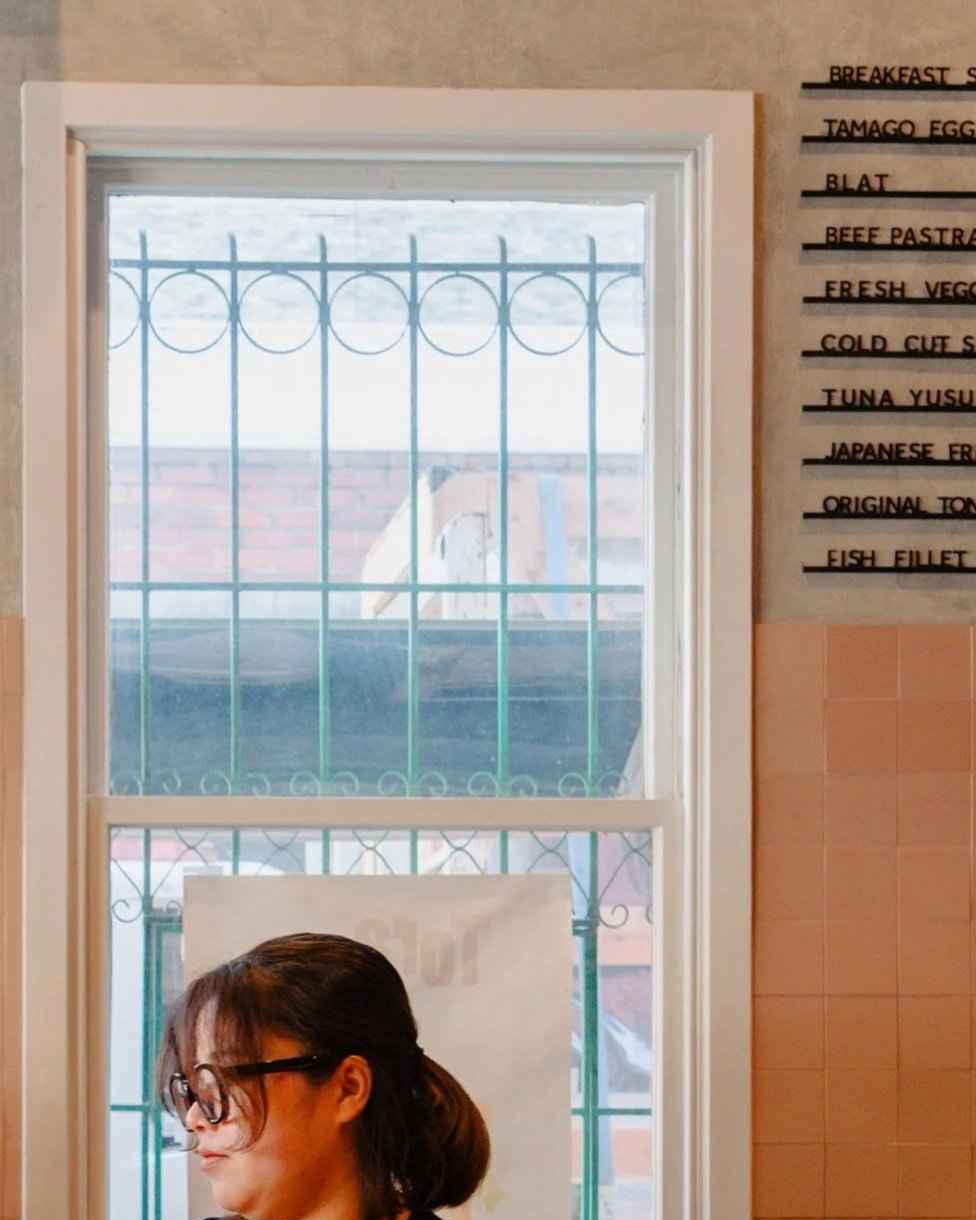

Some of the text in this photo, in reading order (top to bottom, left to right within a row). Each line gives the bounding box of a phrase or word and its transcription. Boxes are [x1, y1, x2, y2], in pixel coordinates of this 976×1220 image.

[829, 65, 949, 84] BREAKFAST
[823, 118, 976, 139] TAMAGO EGG
[825, 173, 889, 191] BLAT
[825, 226, 880, 244] BEEF
[825, 280, 906, 298] FRESH
[820, 334, 887, 352] COLD
[904, 335, 950, 352] CUT
[822, 388, 974, 406] TUNA YUSU
[825, 442, 976, 461] JAPANESE FR
[823, 495, 927, 514] ORIGINAL
[828, 550, 968, 568] FISH FILLET
